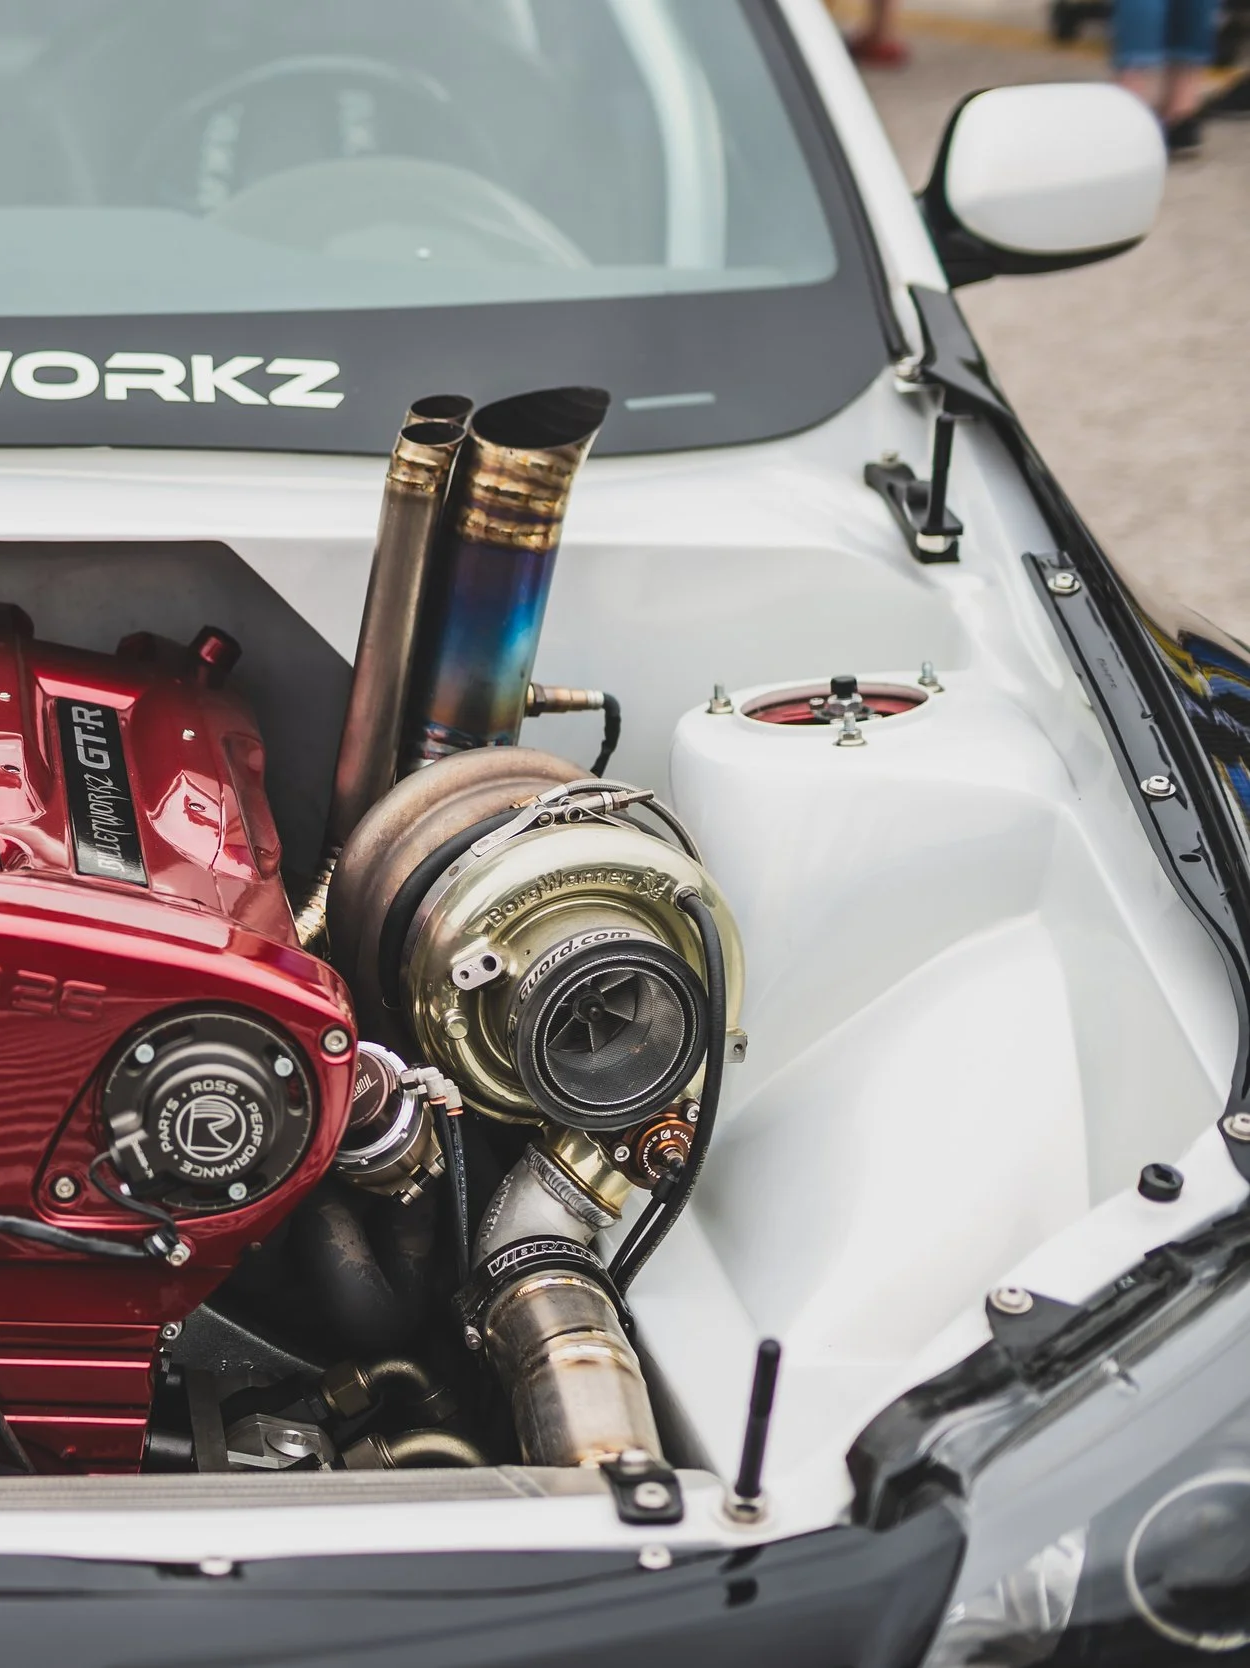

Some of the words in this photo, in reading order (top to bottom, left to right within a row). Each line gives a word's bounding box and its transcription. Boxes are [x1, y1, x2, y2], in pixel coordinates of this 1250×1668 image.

[79, 773, 126, 875] BILLETWORKZ
[485, 868, 634, 928] BorgWarner
[190, 1079, 238, 1096] ROSS
[158, 1098, 180, 1153] PARTS
[179, 1101, 264, 1179] PERFORMANCE
[673, 1130, 693, 1152] FULL
